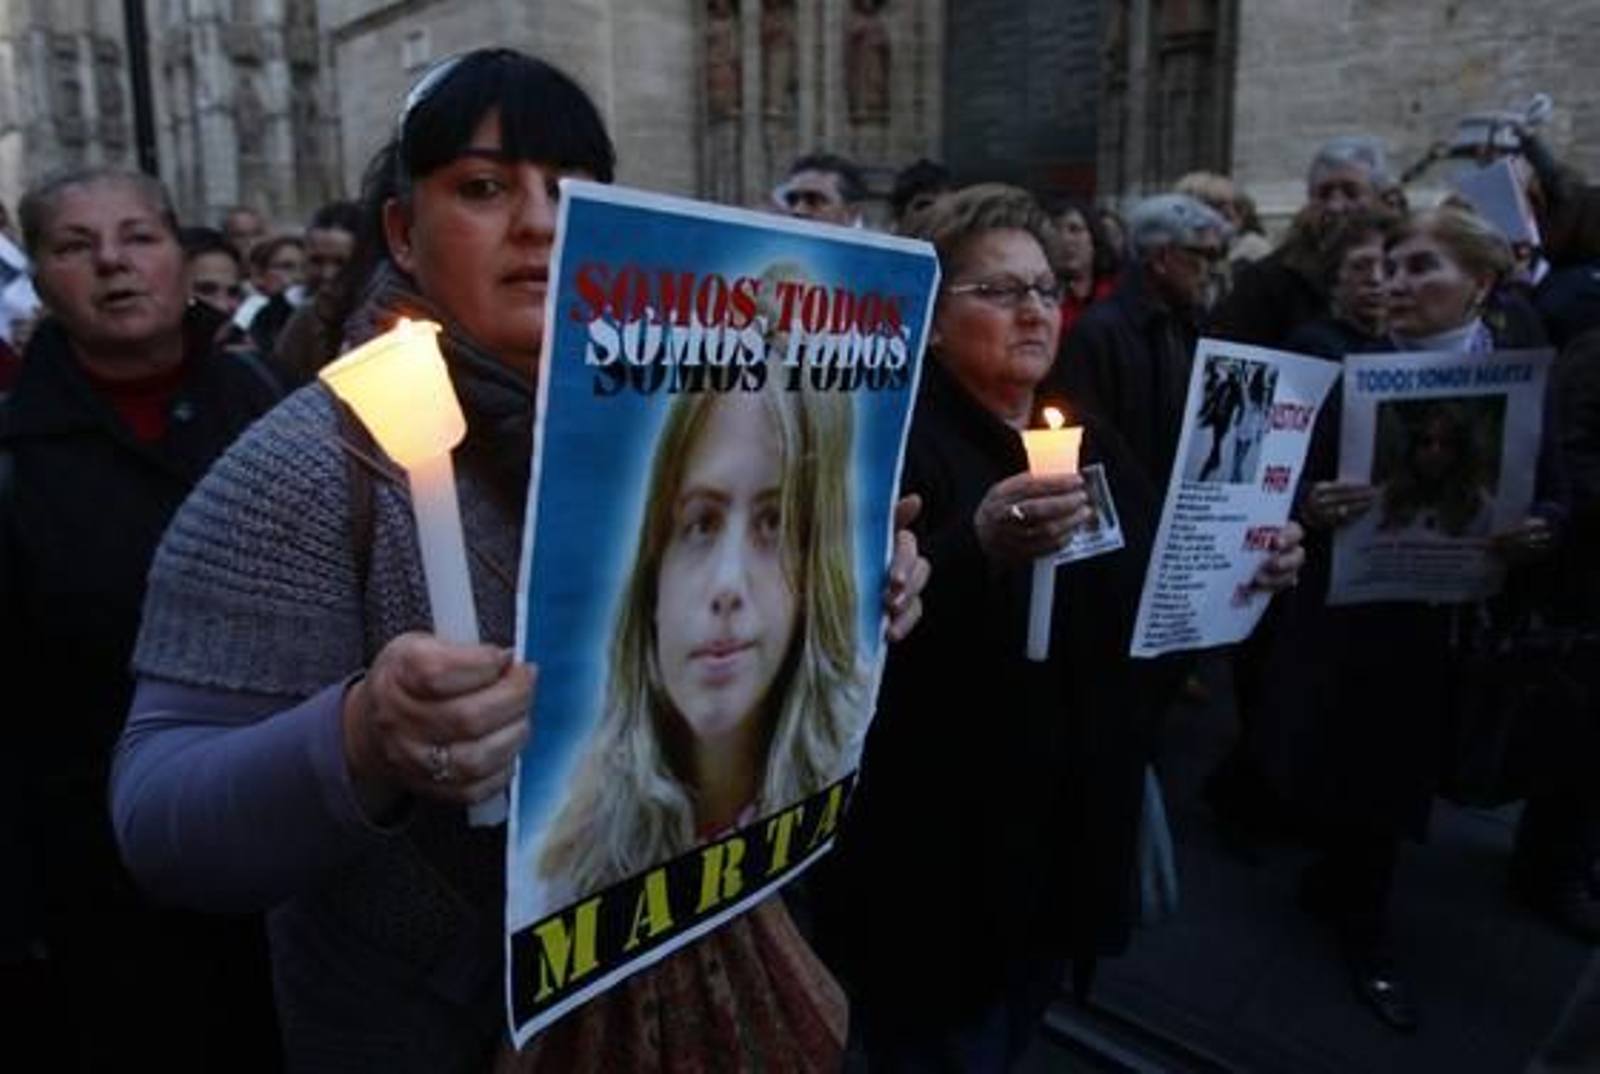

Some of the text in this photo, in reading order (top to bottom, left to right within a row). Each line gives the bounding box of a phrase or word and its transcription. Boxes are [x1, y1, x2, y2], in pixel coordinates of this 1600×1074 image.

[569, 262, 906, 337] SOMOS TODOS
[584, 306, 769, 366] SOMOS
[532, 784, 842, 1003] MARTA
